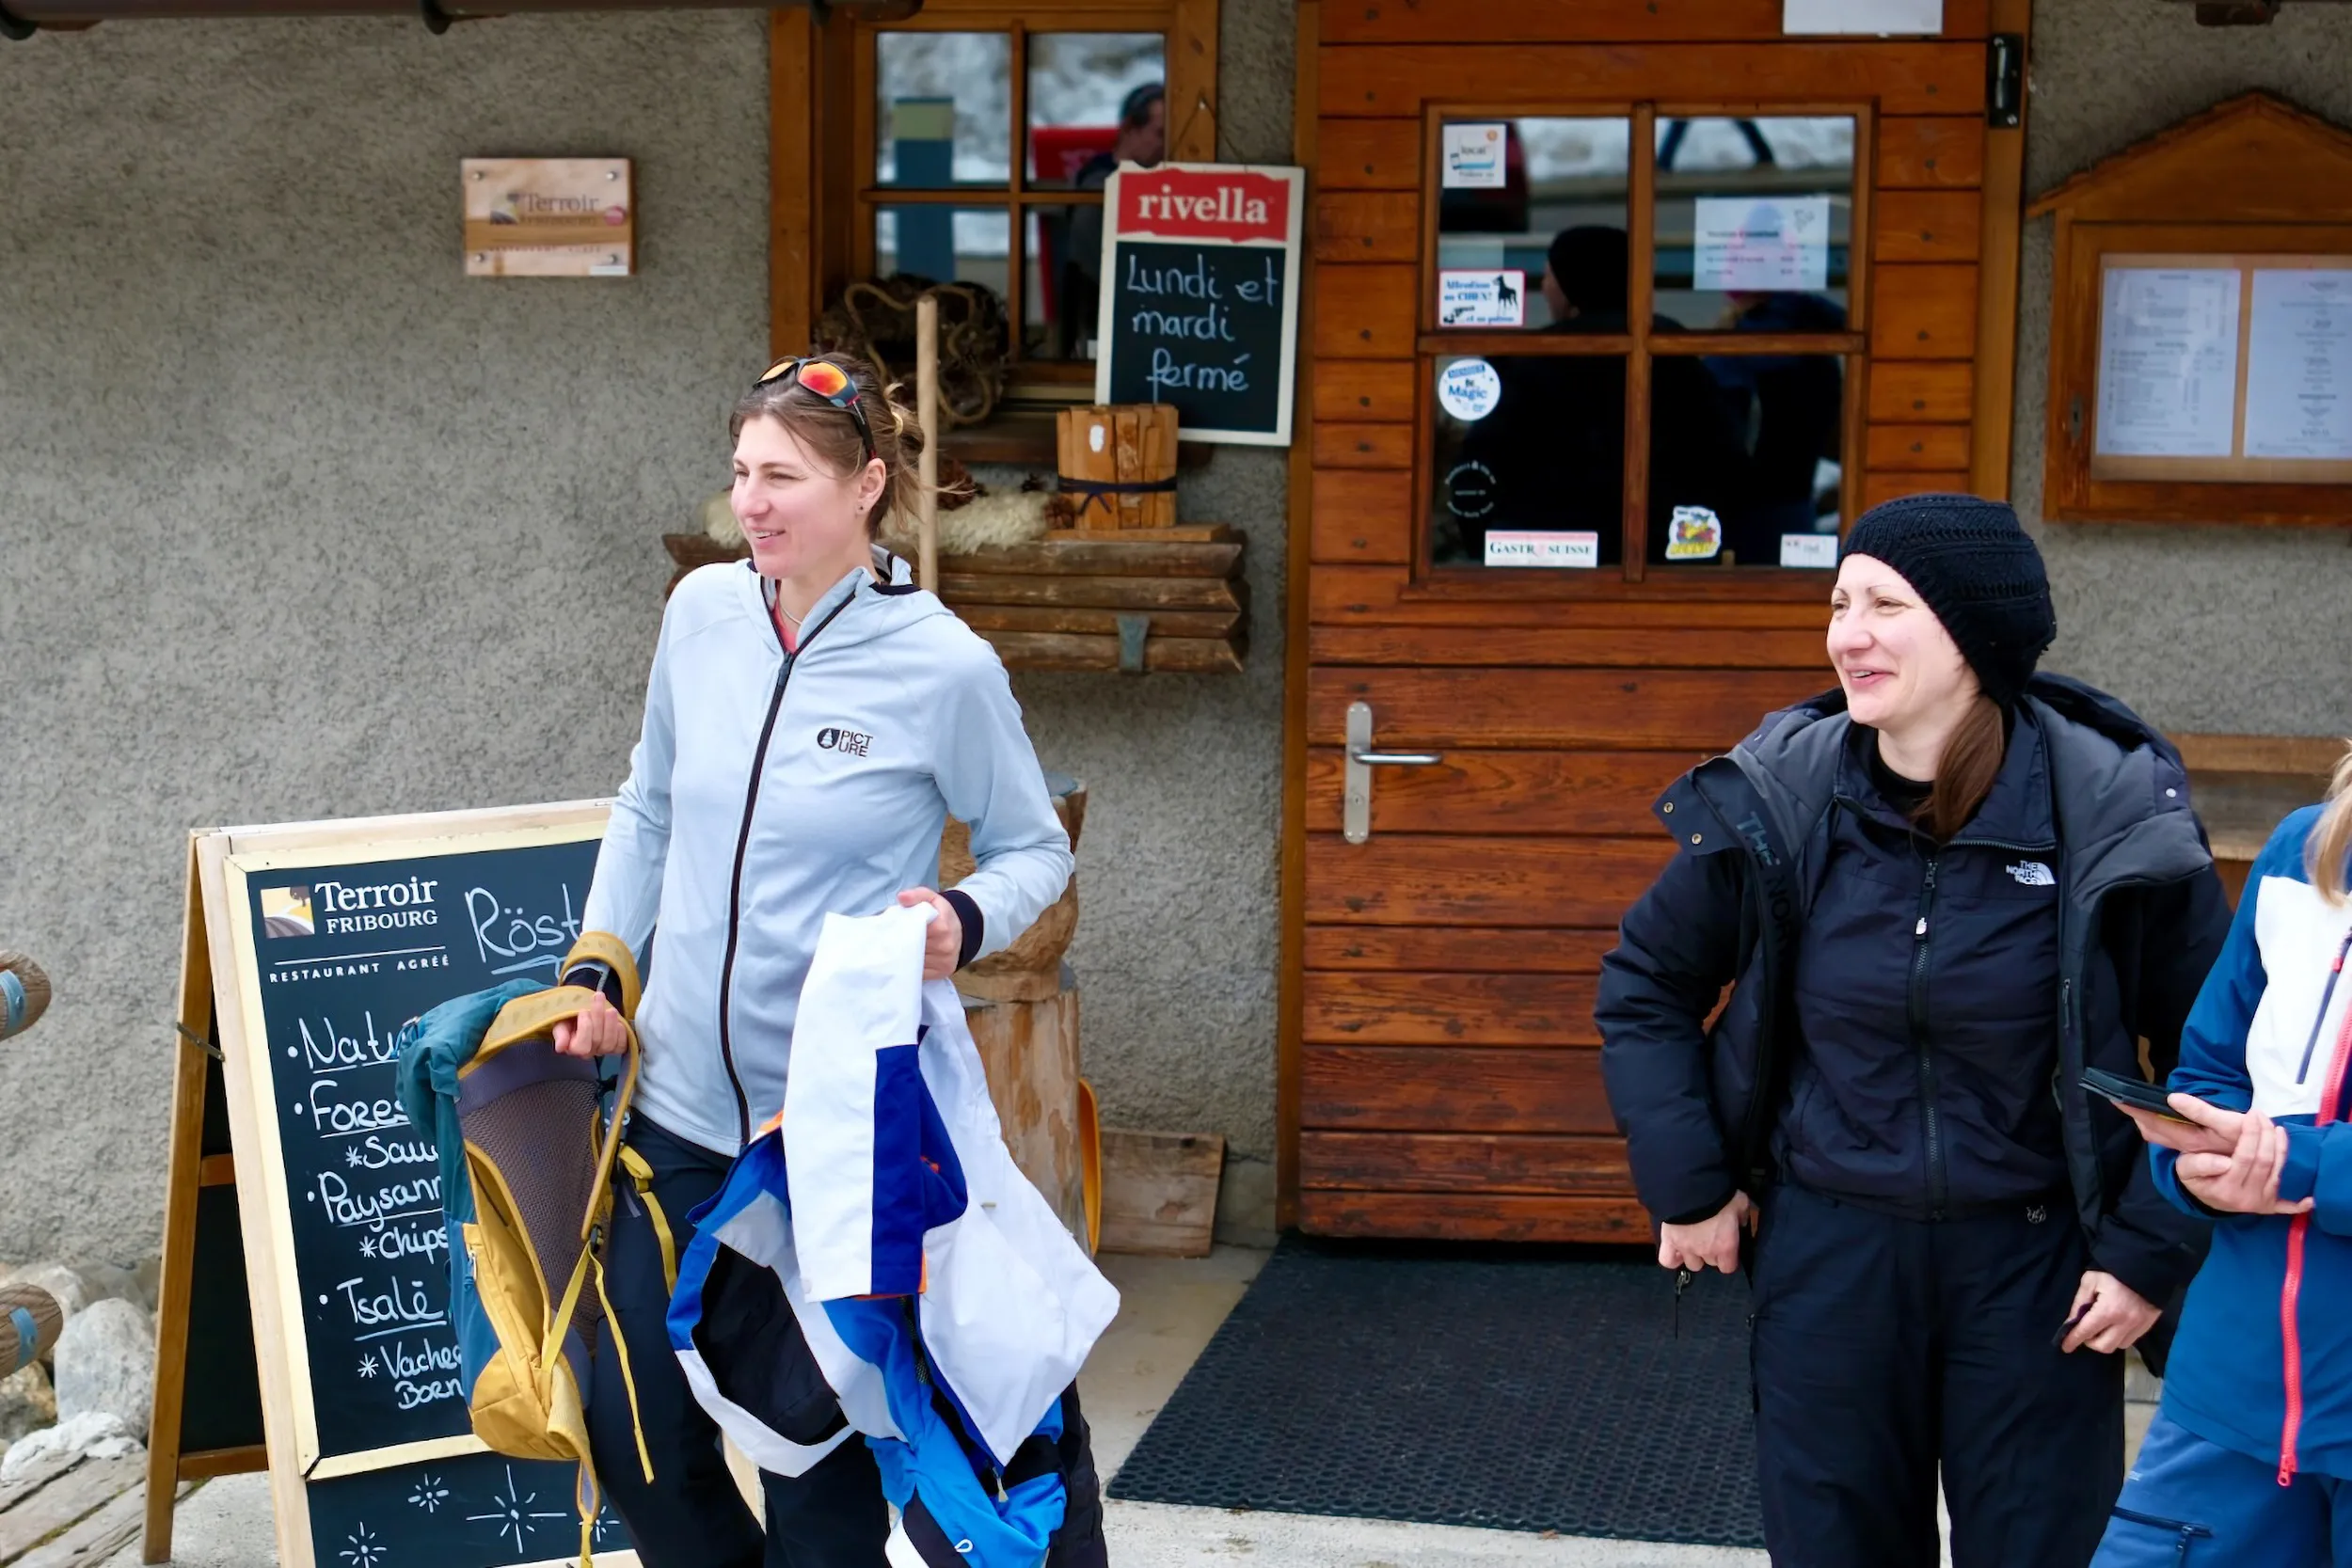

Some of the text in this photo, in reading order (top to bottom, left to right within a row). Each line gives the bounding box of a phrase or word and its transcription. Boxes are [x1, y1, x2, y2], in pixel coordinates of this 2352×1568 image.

[523, 191, 599, 213] Terroir
[1138, 184, 1268, 224] rivella
[1126, 254, 1278, 307] Lundi et
[1132, 303, 1235, 341] mardi
[1146, 348, 1250, 404] fermé
[1448, 384, 1487, 401] Magic
[840, 730, 874, 746] PICT
[314, 876, 438, 912] Terroir
[326, 910, 438, 934] FRIBOURG
[1765, 875, 1798, 961] NOR
[269, 954, 450, 983] RESTAURANT AGRÉÉ
[298, 1010, 405, 1069] Natu
[379, 1222, 449, 1265] Chips
